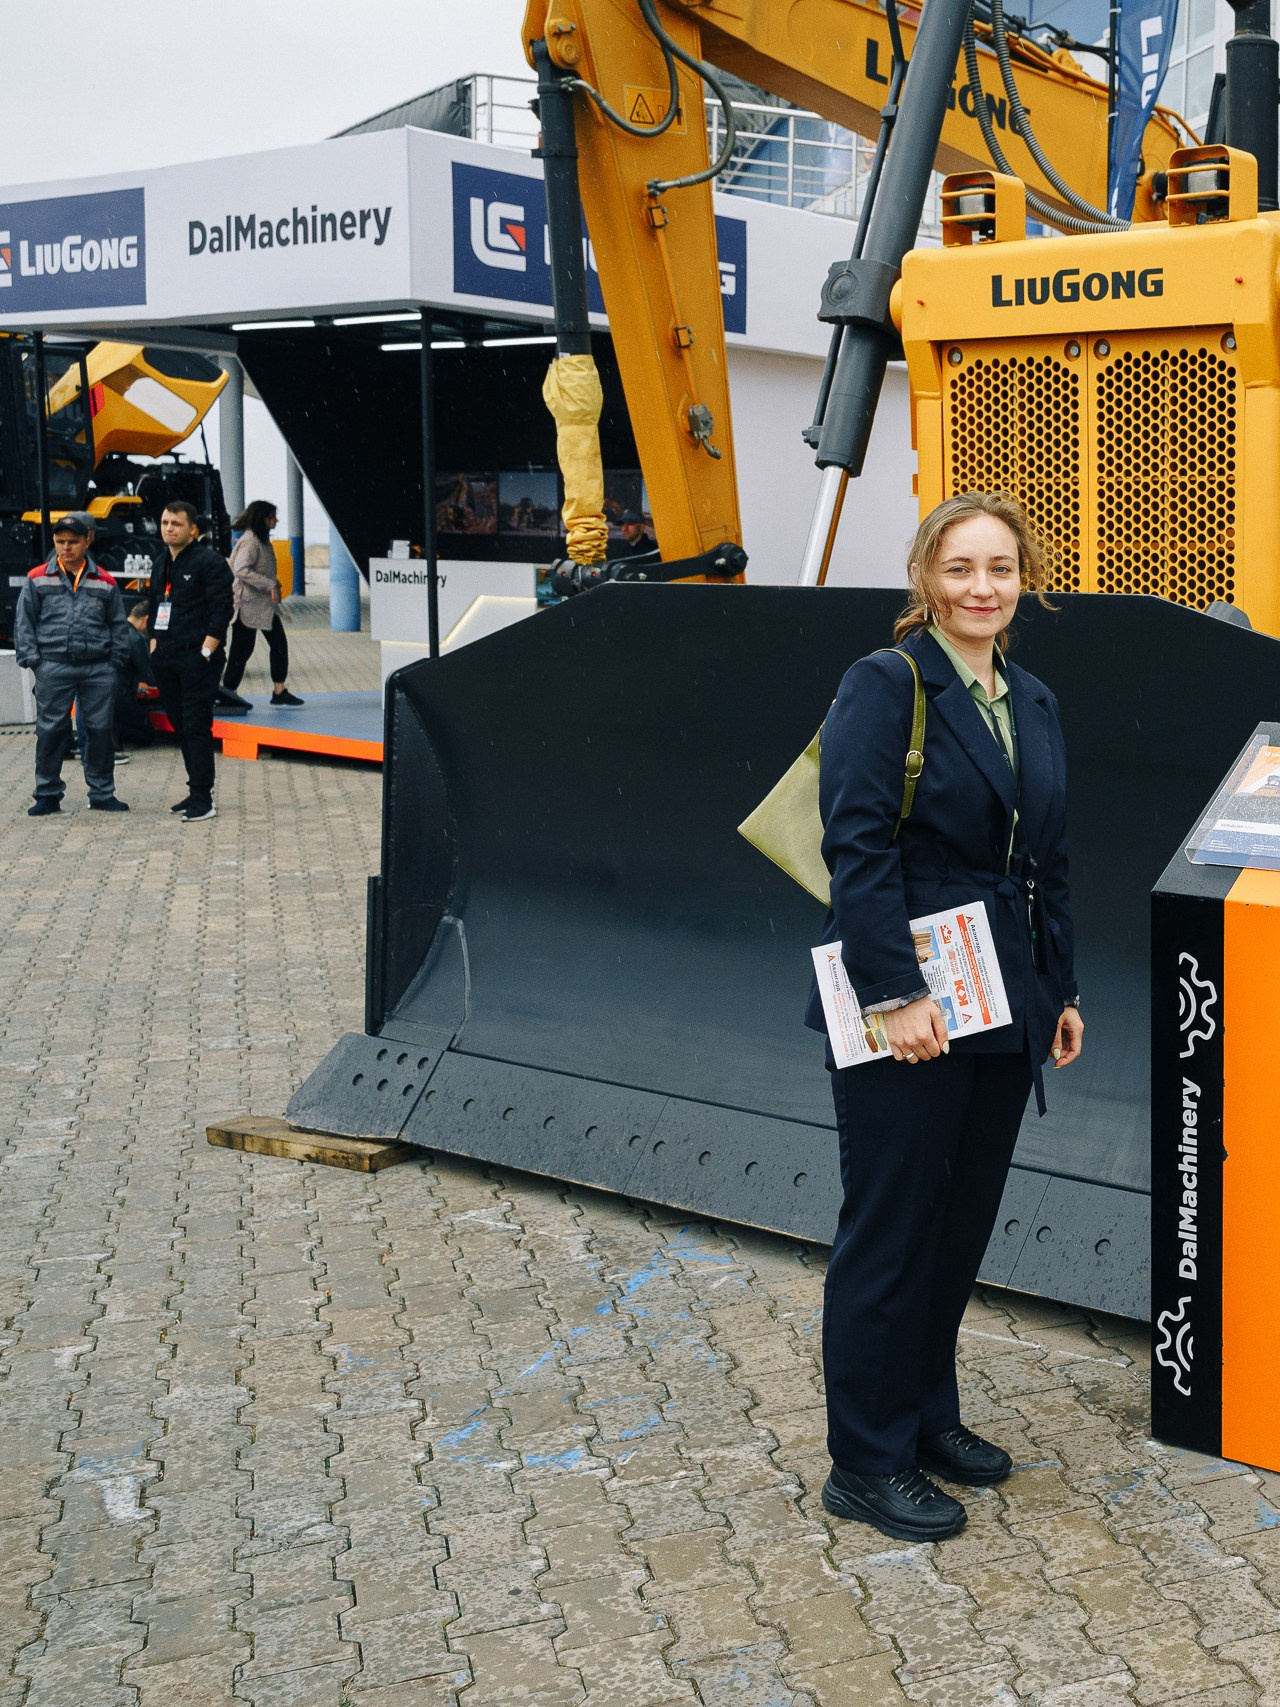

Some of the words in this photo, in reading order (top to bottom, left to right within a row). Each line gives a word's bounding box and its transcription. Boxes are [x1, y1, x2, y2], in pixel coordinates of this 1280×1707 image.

[189, 206, 392, 256] DalMachinery
[376, 570, 447, 588] DalMachinry
[1178, 1077, 1201, 1281] DalMachinery
